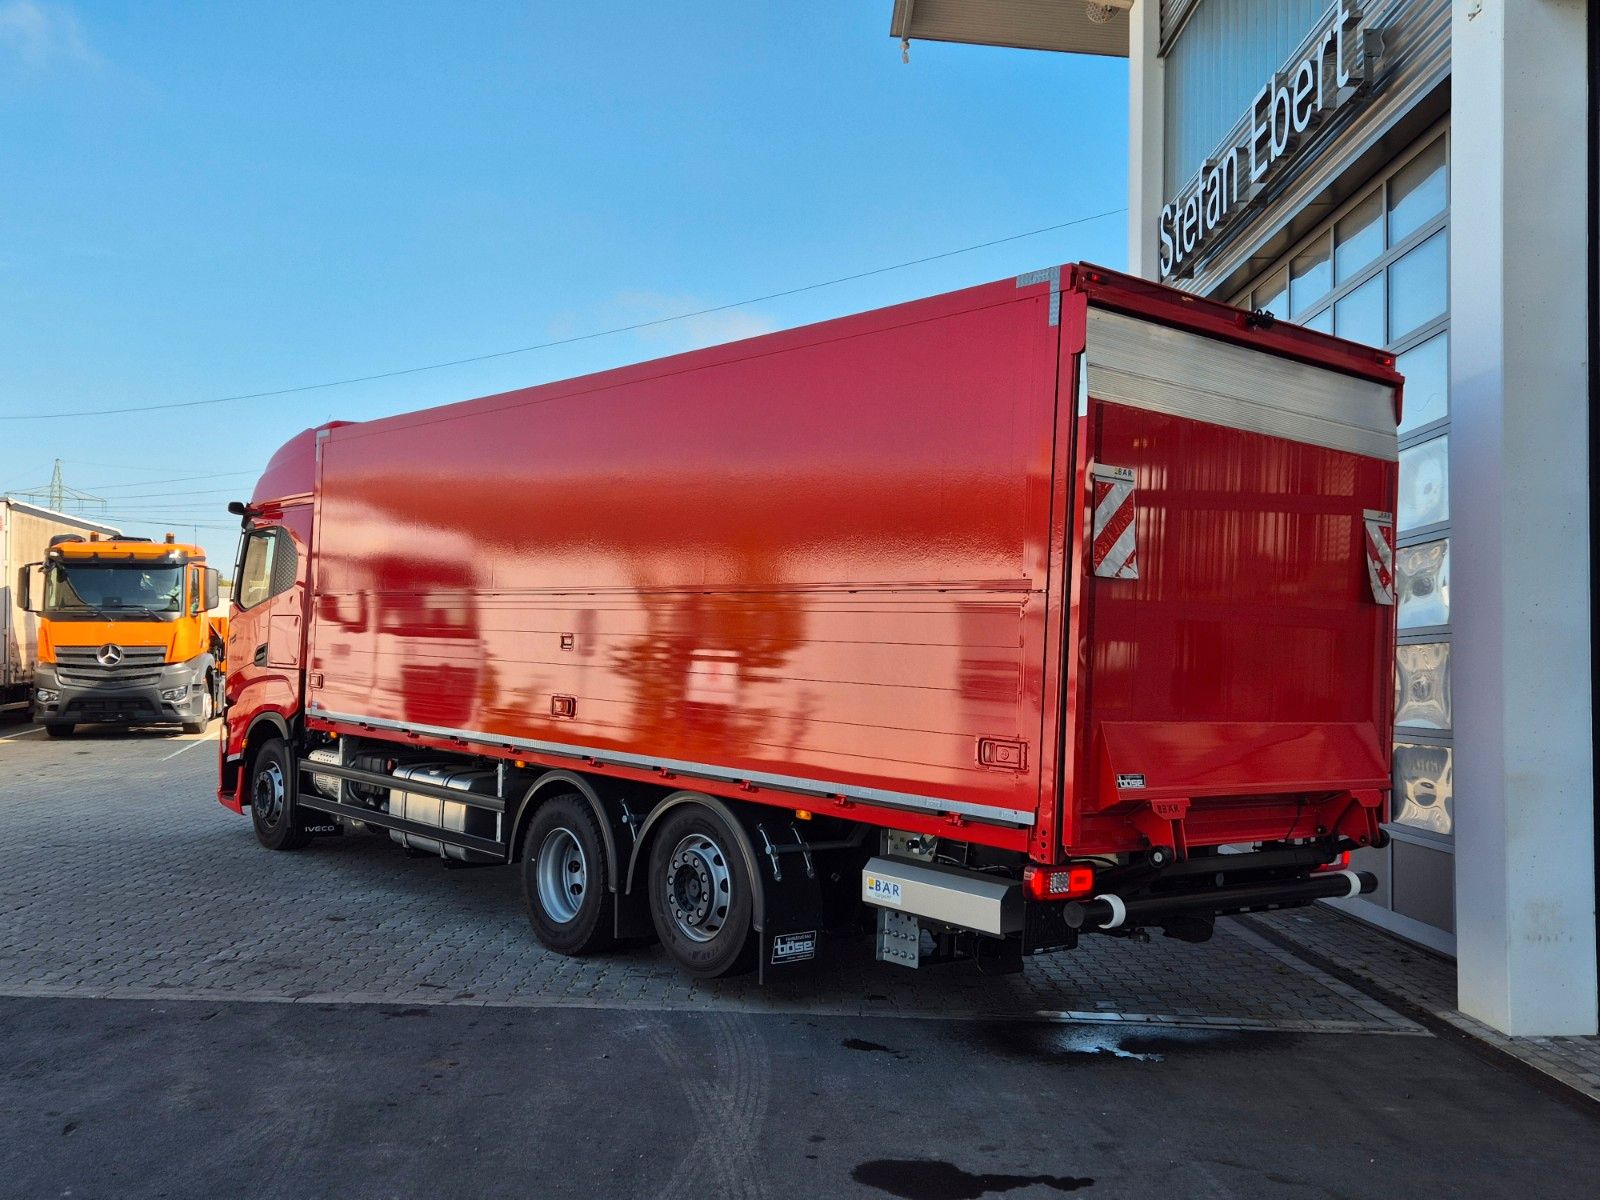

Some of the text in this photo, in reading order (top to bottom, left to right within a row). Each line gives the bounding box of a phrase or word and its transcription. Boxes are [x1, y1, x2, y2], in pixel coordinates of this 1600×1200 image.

[1160, 0, 1350, 277] Stefan Ebert
[875, 880, 900, 897] BÄR
[775, 938, 814, 955] böse
